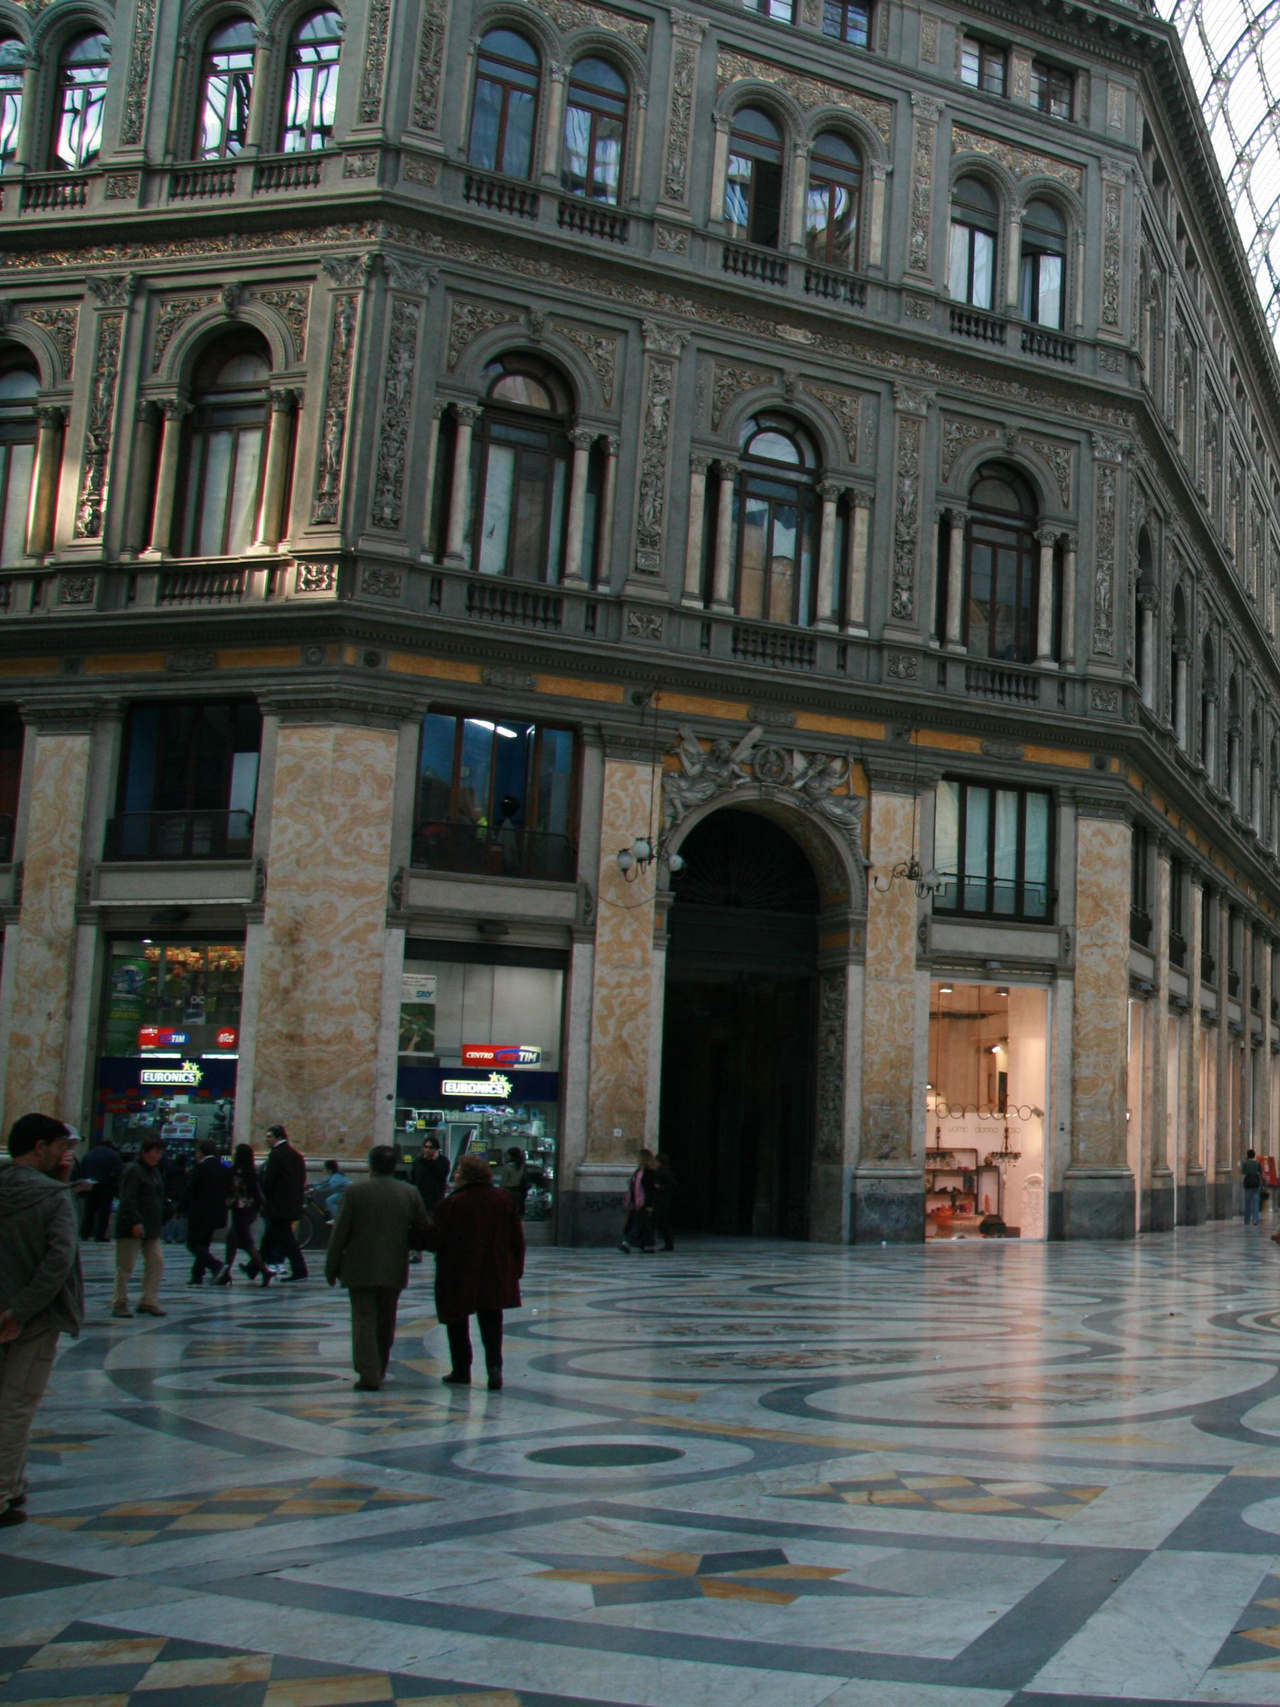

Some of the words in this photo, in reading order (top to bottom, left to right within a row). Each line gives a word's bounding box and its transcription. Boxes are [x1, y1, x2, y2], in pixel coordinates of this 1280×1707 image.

[466, 1051, 494, 1059] CENTRO
[519, 1051, 538, 1062] TIM
[143, 1072, 196, 1083] EURONICS
[445, 1082, 503, 1094] EURONICS
